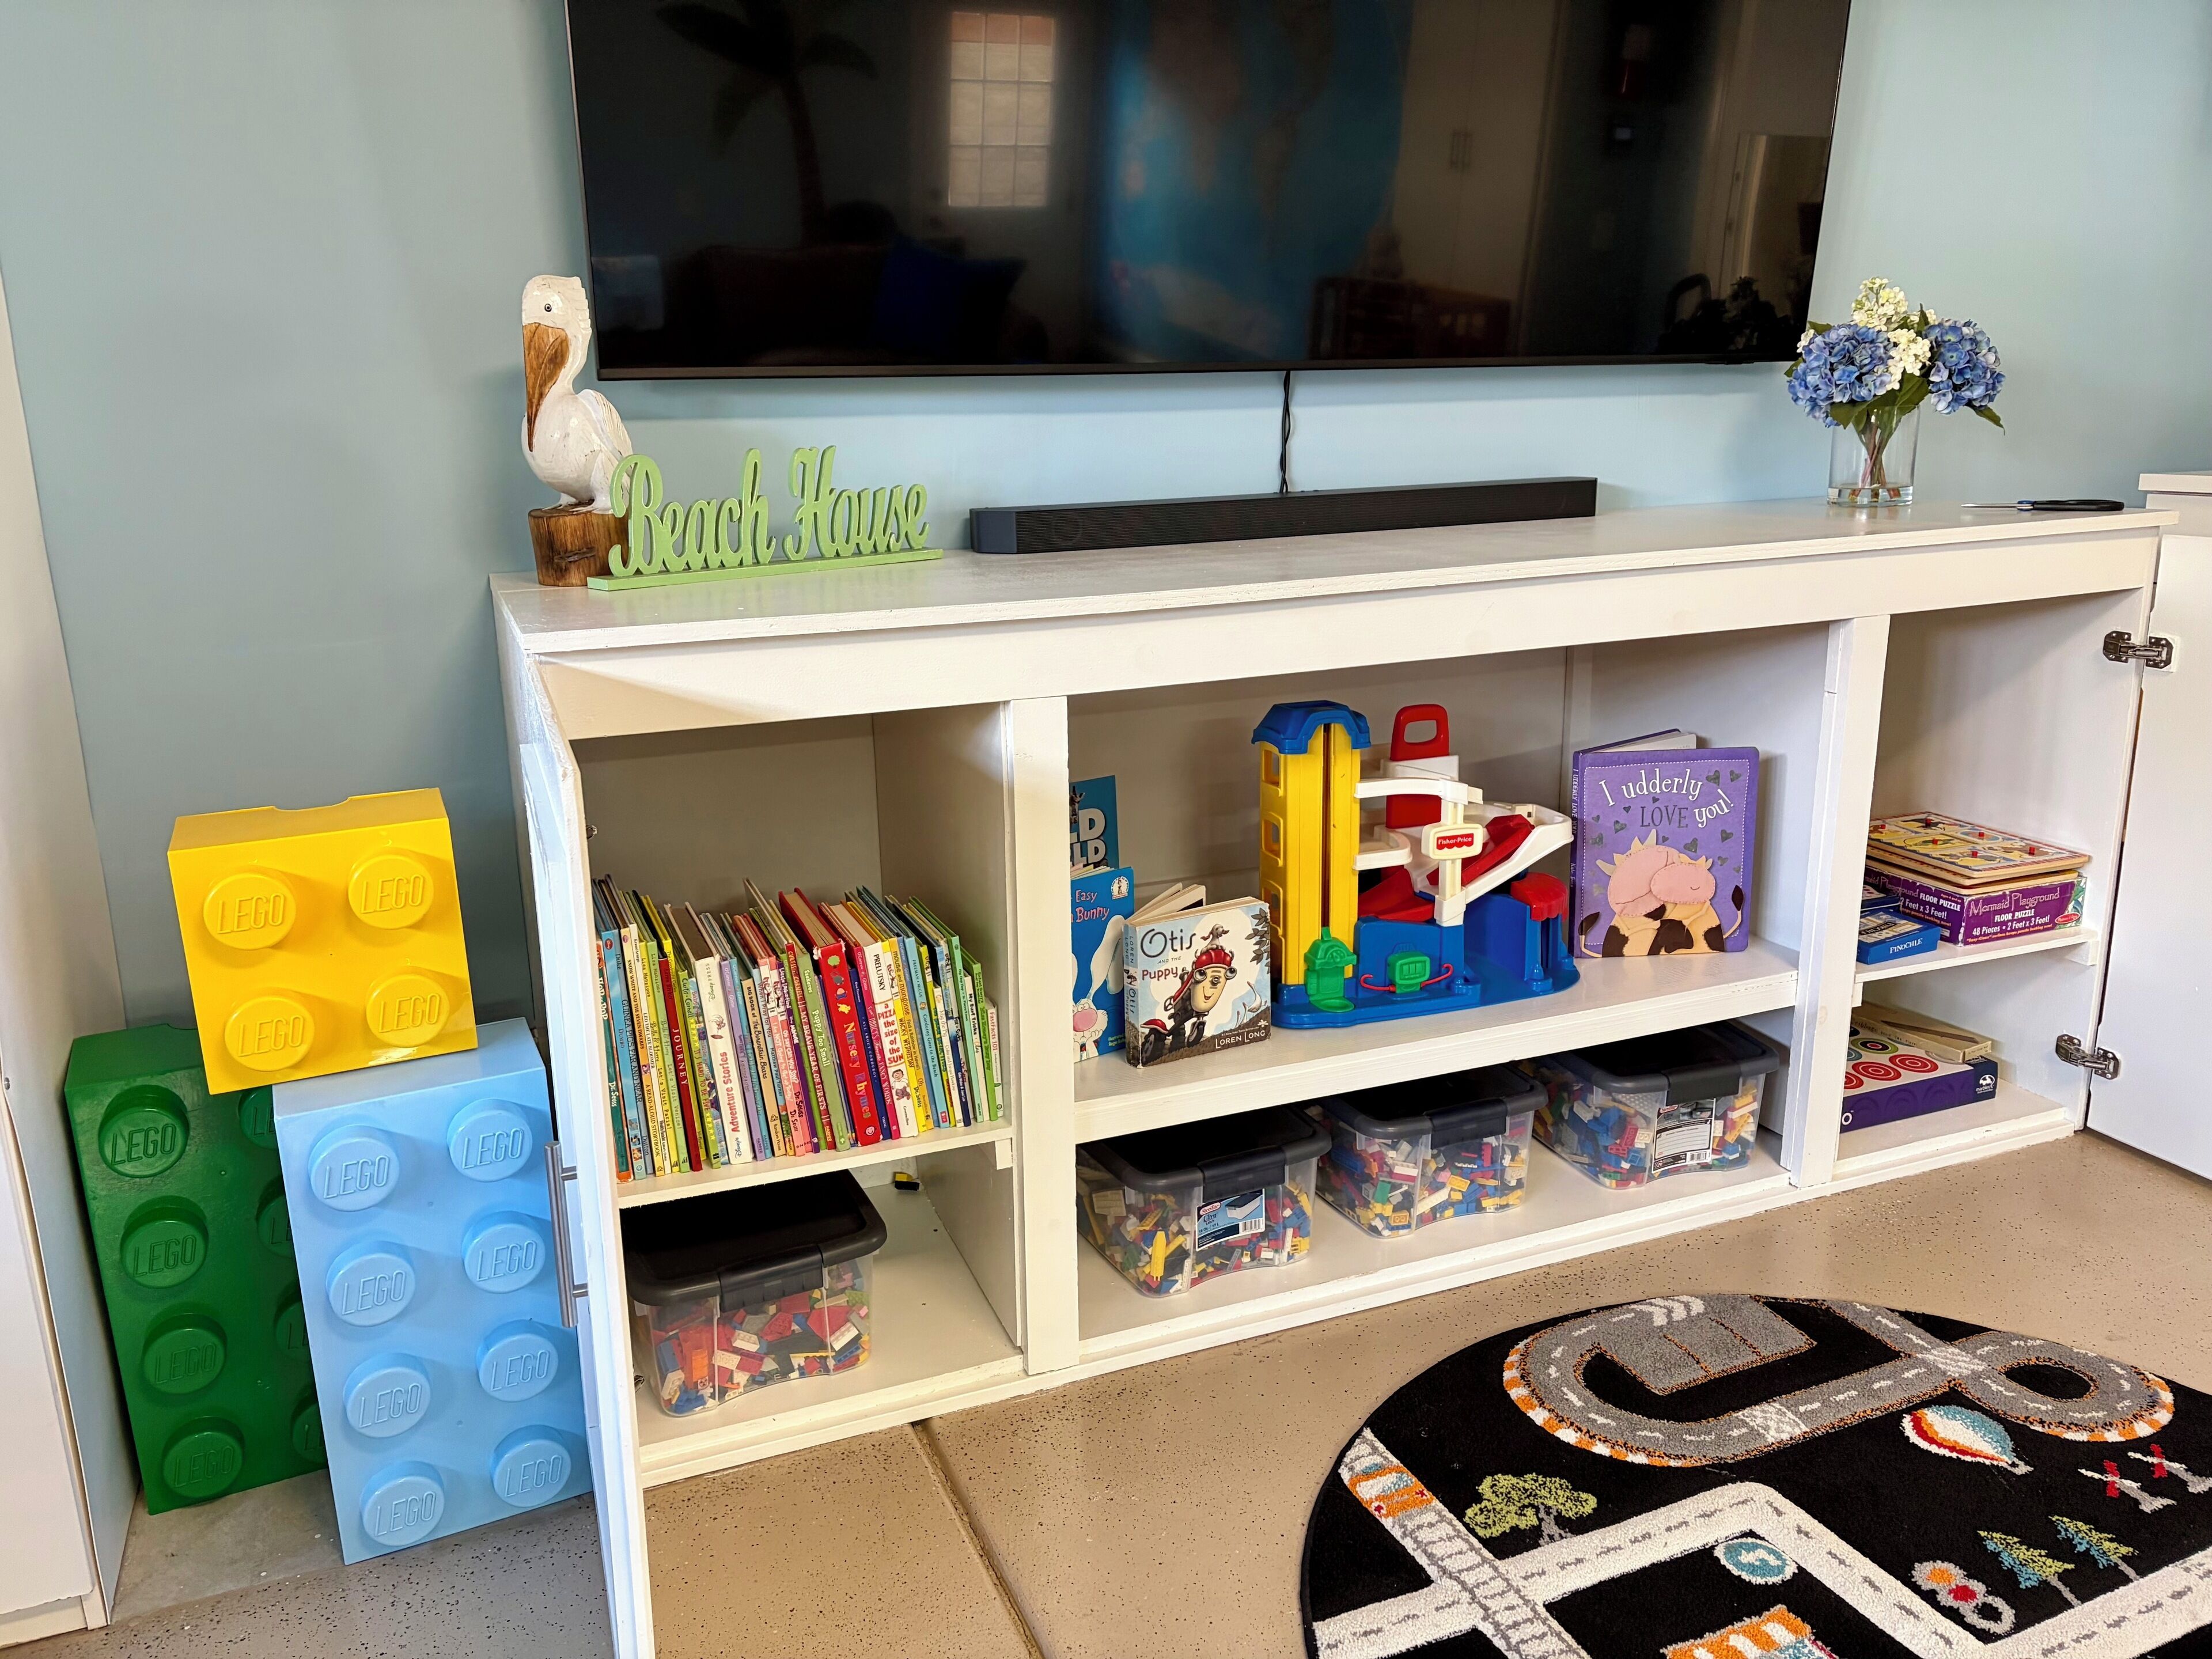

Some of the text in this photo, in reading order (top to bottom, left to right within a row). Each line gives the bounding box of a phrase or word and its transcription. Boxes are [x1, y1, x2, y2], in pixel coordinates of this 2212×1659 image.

[608, 445, 930, 577] Beach House
[1599, 768, 1703, 806] I udderly
[1640, 789, 1734, 828] LOVE you!
[1438, 836, 1472, 845] Fisher-Price
[361, 874, 425, 914] LEGO
[1075, 889, 1097, 903] Easy
[1969, 887, 2060, 917] Mermaid Playground
[216, 893, 285, 934] LEGO
[1075, 906, 1110, 923] Bunny
[1982, 926, 2000, 934] Pieces
[2013, 921, 2024, 929] Feet
[2036, 915, 2050, 925] Feet!
[1995, 909, 2035, 922] FLOOR PUZZLE
[1140, 928, 1196, 958] Otis
[1889, 938, 1923, 954] PINOCHLE
[615, 953, 623, 970] Duke
[787, 950, 803, 999] CURTIS CORNELL
[872, 953, 887, 991] PRELUTSKY
[1142, 967, 1178, 982] Puppy
[681, 978, 694, 1018] Curtis Cornell
[756, 982, 765, 998] When
[1128, 988, 1137, 1014] Otis
[378, 993, 441, 1033] LEGO
[759, 1003, 768, 1016] Pray
[800, 1011, 808, 1022] MY
[878, 1008, 895, 1020] PIZZA
[967, 993, 973, 1001] My
[970, 1017, 978, 1035] Tricks
[238, 1015, 305, 1057] LEGO
[751, 1019, 759, 1029] The
[802, 1024, 815, 1050] BRAVE
[810, 1009, 831, 1066] Puppy Too Small
[885, 1028, 897, 1037] size
[988, 1012, 997, 1039] FastFacts
[620, 999, 642, 1103] GUINEA PIGS FAR AND NEAR
[637, 1029, 645, 1049] DWARFS
[752, 1028, 766, 1060] Berenstain
[897, 1017, 915, 1069] WACKY WEDNESDAY
[921, 1013, 931, 1036] Corduroy
[931, 1063, 939, 1077] Beach
[1215, 1035, 1241, 1049] LOREN
[1244, 1030, 1266, 1043] LONG
[647, 1046, 655, 1069] BLOOMER
[671, 1028, 688, 1085] JOURNEY
[695, 1061, 704, 1078] HARD
[759, 1060, 769, 1080] Bears
[769, 1047, 778, 1068] Matthew
[808, 1050, 819, 1072] YEAR
[842, 1021, 874, 1119] Nursery Rhymes
[867, 1051, 877, 1078] CORDUROY
[888, 1055, 903, 1065] SUN
[698, 1079, 706, 1087] TO
[812, 1073, 821, 1082] OF
[916, 1077, 925, 1086] Oh
[609, 1091, 618, 1107] Seuss
[700, 1089, 707, 1097] BE
[702, 1098, 710, 1111] FIVE
[718, 1051, 740, 1133] Adventure Stories
[793, 1091, 805, 1118] Dr. Seuss
[815, 1083, 827, 1109] FIRSTS
[914, 1094, 923, 1108] Seuss
[645, 1089, 656, 1127] READ-ALOUD
[789, 1109, 799, 1132] Dr. Seuss
[111, 1123, 176, 1165] LEGO
[641, 1135, 650, 1156] Dutton
[650, 1127, 661, 1157] STORYBOOK
[824, 1124, 832, 1141] HARPER
[461, 1127, 524, 1169] LEGO
[323, 1154, 390, 1199] LEGO
[1203, 1213, 1217, 1222] Ultra
[133, 1234, 198, 1277] LEGO
[476, 1240, 537, 1282] LEGO
[342, 1269, 406, 1316] LEGO
[154, 1342, 217, 1384] LEGO
[490, 1349, 550, 1392] LEGO
[359, 1383, 422, 1427] LEGO
[174, 1445, 233, 1488] LEGO
[505, 1455, 562, 1498] LEGO
[374, 1491, 436, 1536] LEGO
